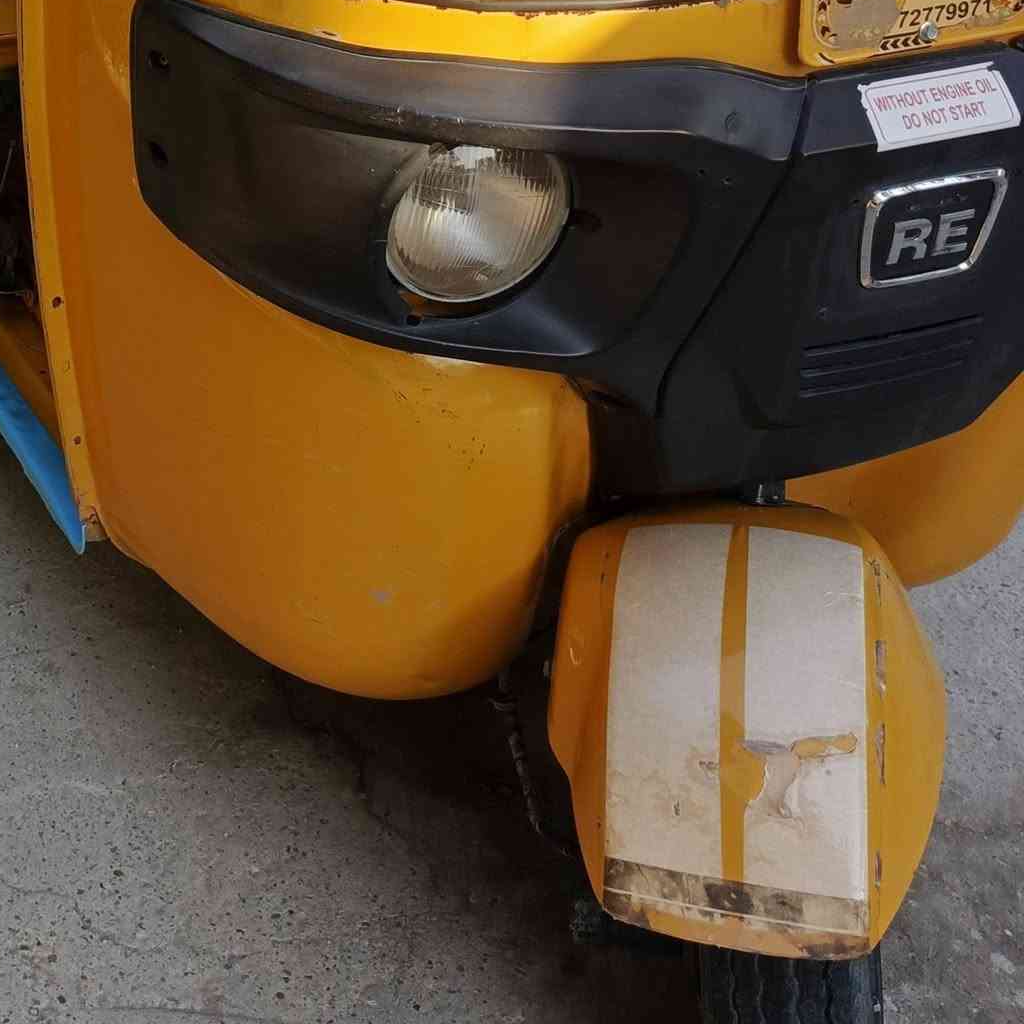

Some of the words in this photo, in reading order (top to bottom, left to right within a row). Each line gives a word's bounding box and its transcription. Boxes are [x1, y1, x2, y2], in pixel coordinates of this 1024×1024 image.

[873, 89, 929, 113] WITHOUT
[929, 80, 976, 102] ENGINE
[975, 77, 997, 95] OIL
[902, 112, 922, 130] DO
[921, 108, 948, 128] NOT
[949, 101, 987, 121] START
[885, 208, 976, 265] RE
